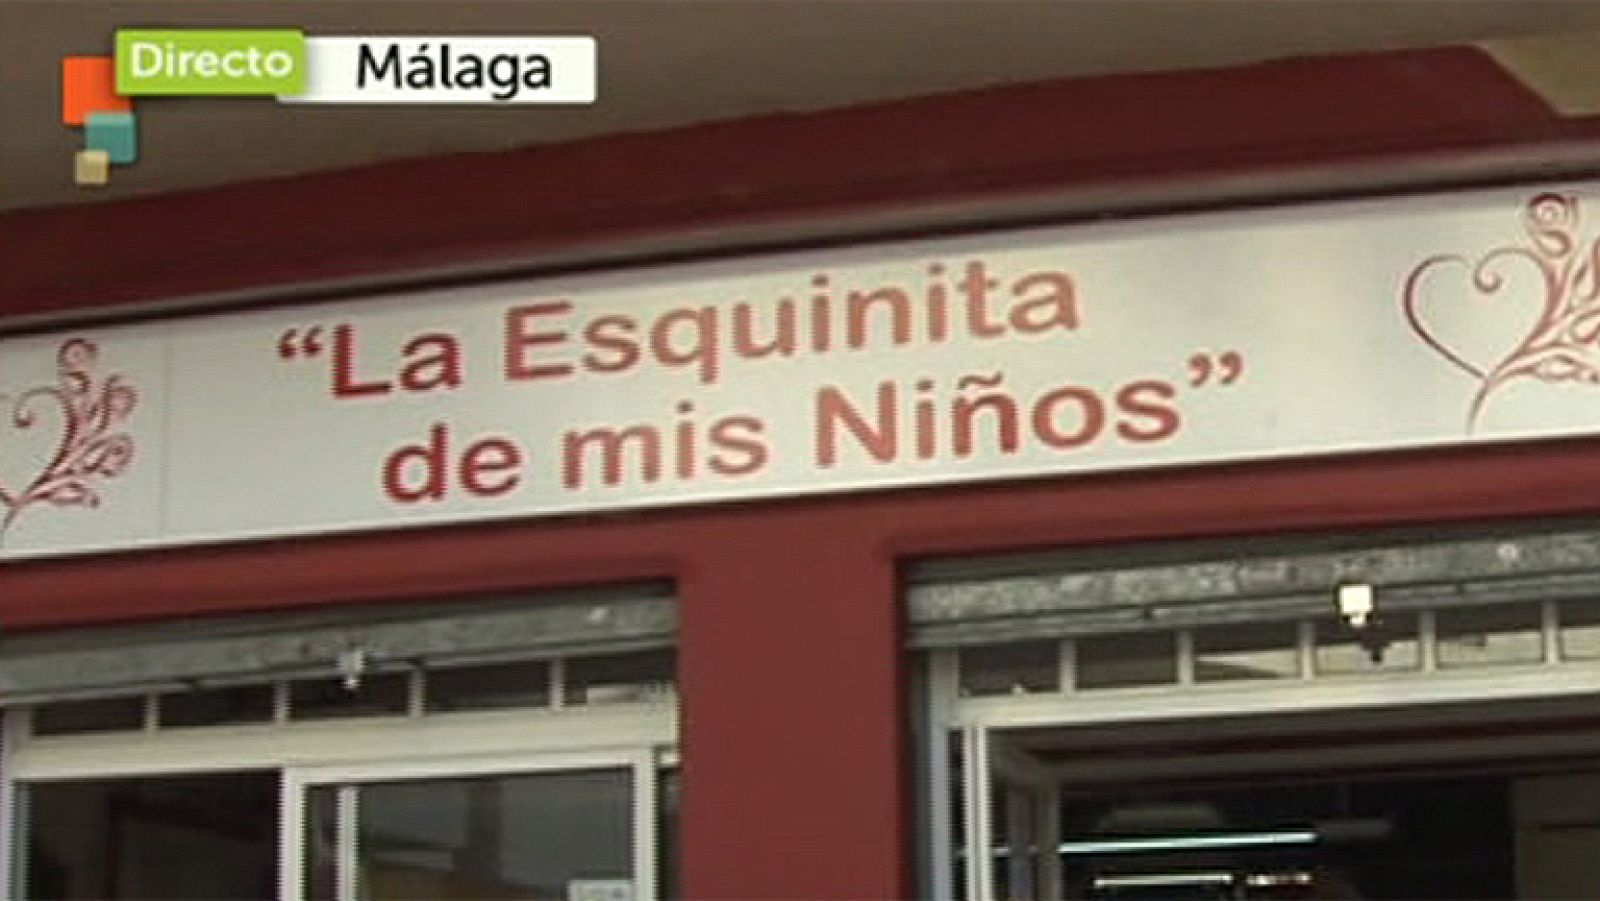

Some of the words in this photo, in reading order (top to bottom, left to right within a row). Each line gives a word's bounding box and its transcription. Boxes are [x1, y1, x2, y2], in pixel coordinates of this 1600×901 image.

[277, 323, 462, 399] “La
[504, 260, 1080, 384] Esquinita
[382, 422, 523, 502] de
[561, 400, 768, 490] mis
[815, 350, 1243, 468] Niños”
